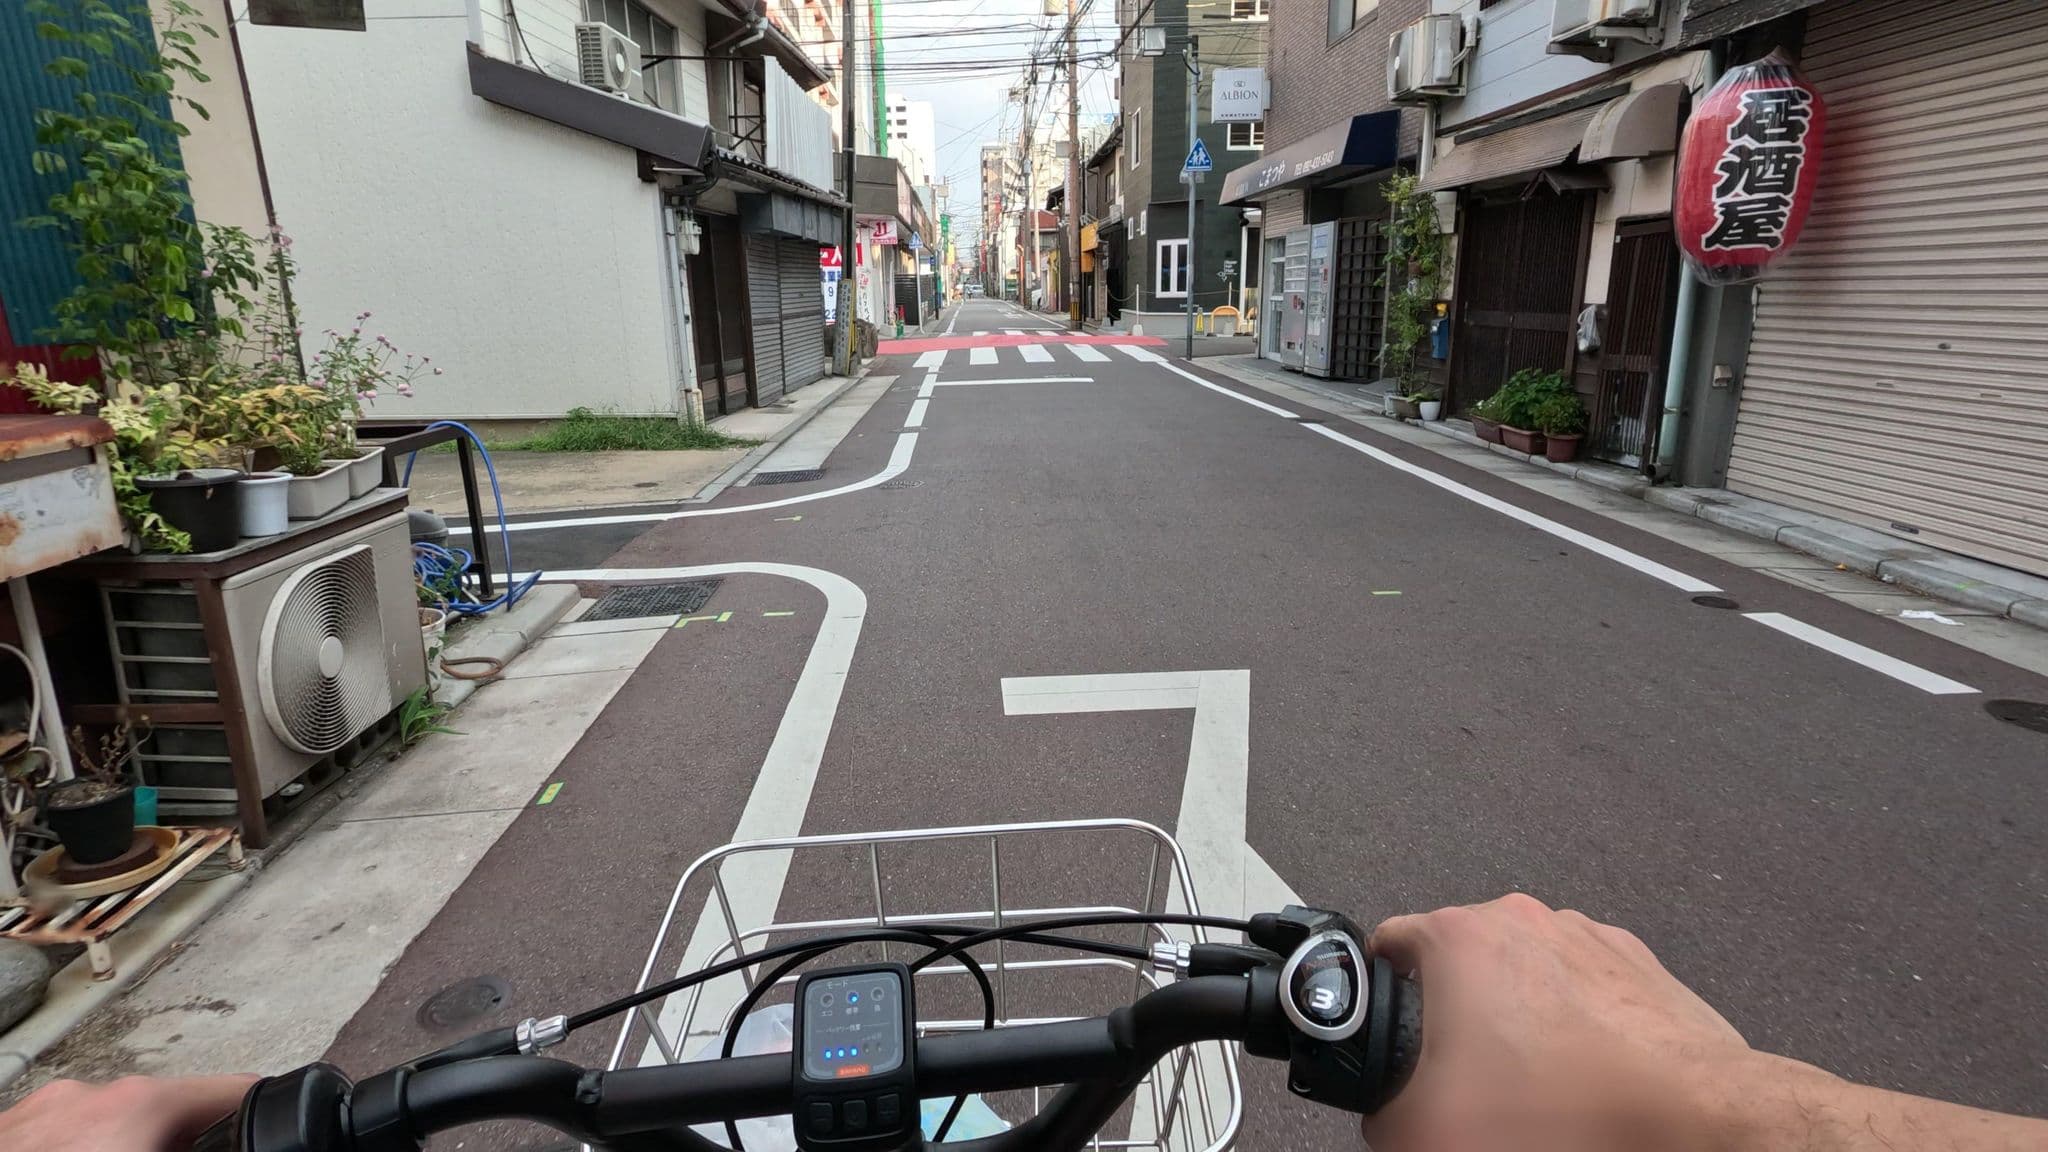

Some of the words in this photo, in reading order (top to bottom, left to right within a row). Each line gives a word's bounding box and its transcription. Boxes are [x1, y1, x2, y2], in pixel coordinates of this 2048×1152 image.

[1220, 90, 1258, 100] ALBION
[1259, 160, 1286, 188] こまつや
[1702, 87, 1813, 250] 居酒屋
[828, 286, 834, 297] 9
[827, 980, 848, 989] モード
[1311, 987, 1335, 1010] 3
